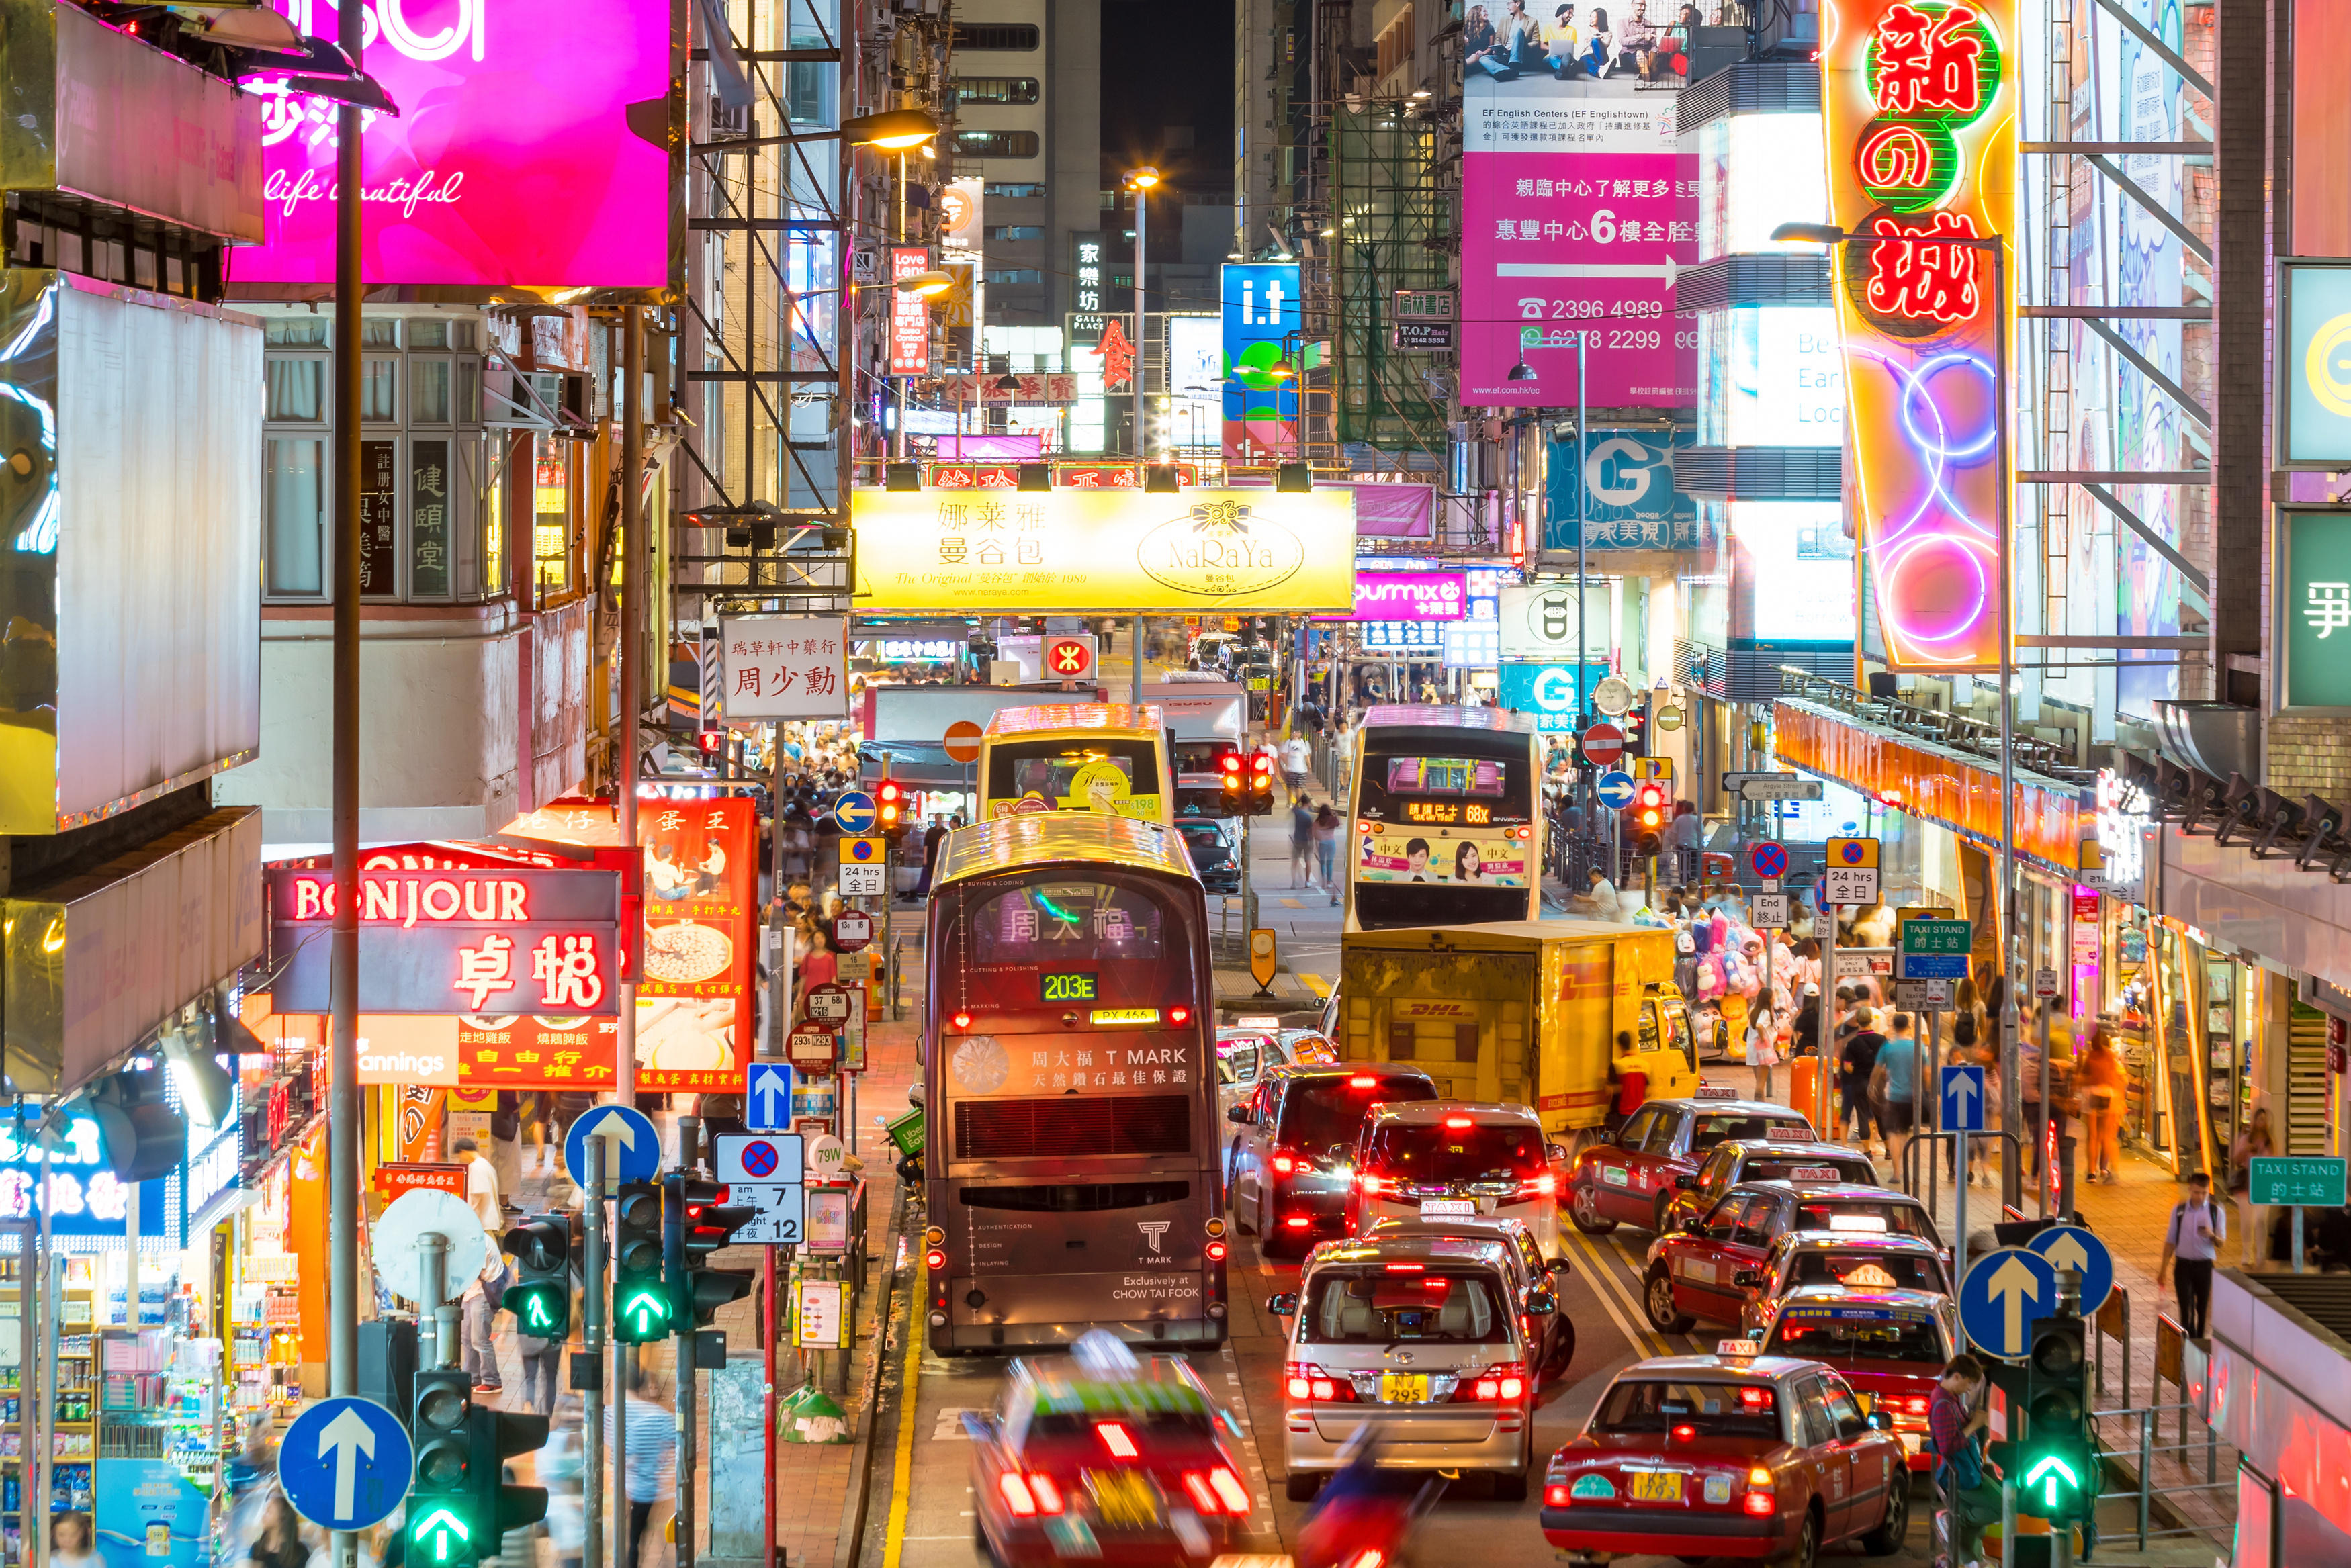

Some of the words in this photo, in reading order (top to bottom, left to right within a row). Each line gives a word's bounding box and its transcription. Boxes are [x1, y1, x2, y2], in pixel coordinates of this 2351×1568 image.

[1497, 109, 1531, 120] English
[1534, 110, 1568, 118] Centers
[1572, 110, 1586, 119] (EF
[1590, 110, 1649, 120] Englishtown)
[264, 169, 323, 217] life
[1516, 179, 1669, 198] 親臨中心了解更多
[895, 253, 925, 265] Love
[895, 265, 926, 277] Lens
[1079, 242, 1100, 311] 家樂坊
[897, 303, 923, 316] 眼鏡
[1399, 295, 1450, 315] 榆林書店
[1552, 300, 1604, 318] 2396
[1610, 299, 1662, 319] 4989
[895, 316, 925, 327] 專門店
[1075, 315, 1102, 324] GALA
[1073, 322, 1104, 330] PLACE
[1401, 326, 1431, 336] T.O.P
[1609, 330, 1661, 349] 2299
[903, 349, 916, 357] 3/F
[1090, 319, 1136, 388] 食
[1472, 386, 1540, 394] www.ef.com.hk/ec
[939, 537, 1043, 565] 曼谷包
[1169, 539, 1274, 569] NaRaYa
[895, 573, 918, 584] The
[922, 573, 972, 587] Original
[1062, 573, 1087, 584] 1989
[1205, 574, 1235, 583] 曼谷包
[953, 588, 1029, 597] www.naraya.com
[1415, 601, 1460, 616] 卡萊美
[731, 638, 837, 657] 瑞草軒中藥行
[1130, 798, 1155, 810] $198
[1409, 803, 1458, 817] 請讓巴士
[1380, 843, 1402, 856] 中文
[1487, 847, 1509, 860] 中文
[845, 867, 859, 876] 24
[863, 867, 880, 876] hrs
[1832, 871, 1849, 881] 24
[1853, 872, 1872, 882] hrs
[848, 879, 877, 892] 全日
[1835, 884, 1867, 900] 全日
[1761, 898, 1779, 907] End
[1757, 911, 1783, 923] 終止
[857, 921, 864, 929] 16
[1010, 908, 1124, 941] 周大福
[1908, 925, 1931, 933] TAXI
[1933, 925, 1965, 934] STAND
[1914, 937, 1959, 949] 的士站
[850, 956, 858, 964] 16
[454, 934, 602, 1011] 卓悅
[1045, 974, 1094, 999] 203E
[815, 996, 823, 1005] 37
[811, 1007, 828, 1017] N216
[1102, 1011, 1118, 1020] PX
[1124, 1011, 1147, 1019] 466
[1410, 1003, 1465, 1016] DHL
[460, 1031, 511, 1044] 走地雞飯
[812, 1035, 831, 1046] N293
[476, 1049, 582, 1064] 自由行
[1032, 1050, 1092, 1068] 周大福
[1106, 1050, 1117, 1065] T
[1127, 1048, 1187, 1064] MARK
[358, 1054, 444, 1076] annings
[1032, 1069, 1187, 1087] 天然鑽石最佳保證
[1700, 1088, 1737, 1098] TAXI
[902, 1124, 924, 1140] Uber
[1771, 1128, 1812, 1140] TAXI
[818, 1147, 841, 1164] 79W
[1798, 1168, 1838, 1179] TAXI
[2257, 1164, 2288, 1175] TAXI
[2292, 1163, 2340, 1175] STAND
[772, 1187, 787, 1206] 7
[2271, 1183, 2325, 1198] 的士站
[733, 1195, 758, 1206] 上午
[1425, 1201, 1472, 1213] TAXI
[734, 1228, 758, 1239] 午夜
[772, 1219, 797, 1238] 12
[1124, 1275, 1176, 1286] Exclusively
[1855, 1275, 1886, 1283] TAXI
[1112, 1289, 1147, 1299] CHOW
[1149, 1289, 1165, 1298] TAI
[1169, 1288, 1200, 1297] FOOK
[1722, 1341, 1756, 1353] TAXI
[1390, 1389, 1421, 1401] 295
